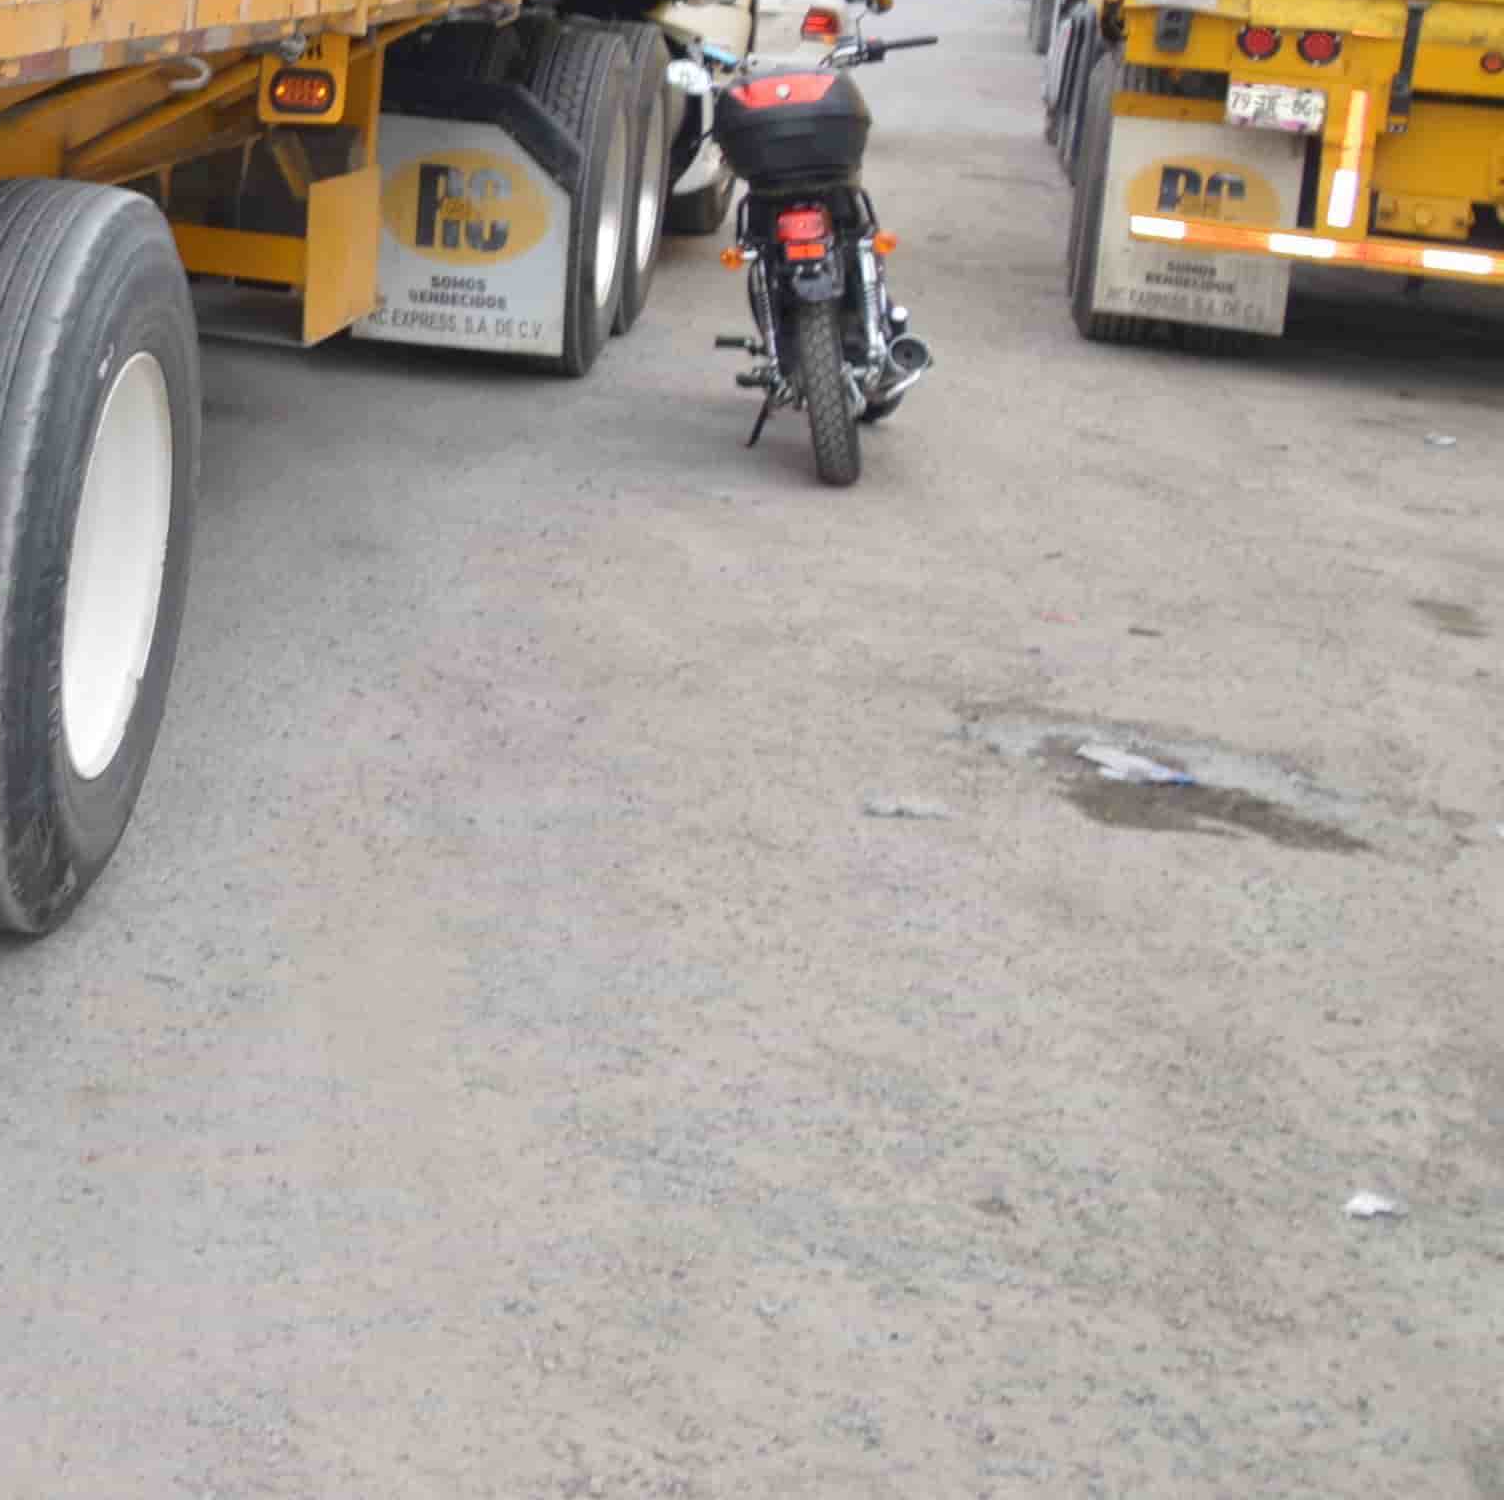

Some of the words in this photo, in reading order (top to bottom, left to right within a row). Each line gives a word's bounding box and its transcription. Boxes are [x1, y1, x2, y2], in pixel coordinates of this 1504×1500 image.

[415, 163, 512, 253] RC
[430, 275, 487, 292] SOMOS
[390, 309, 457, 333] EXPRESS
[495, 317, 513, 337] DE
